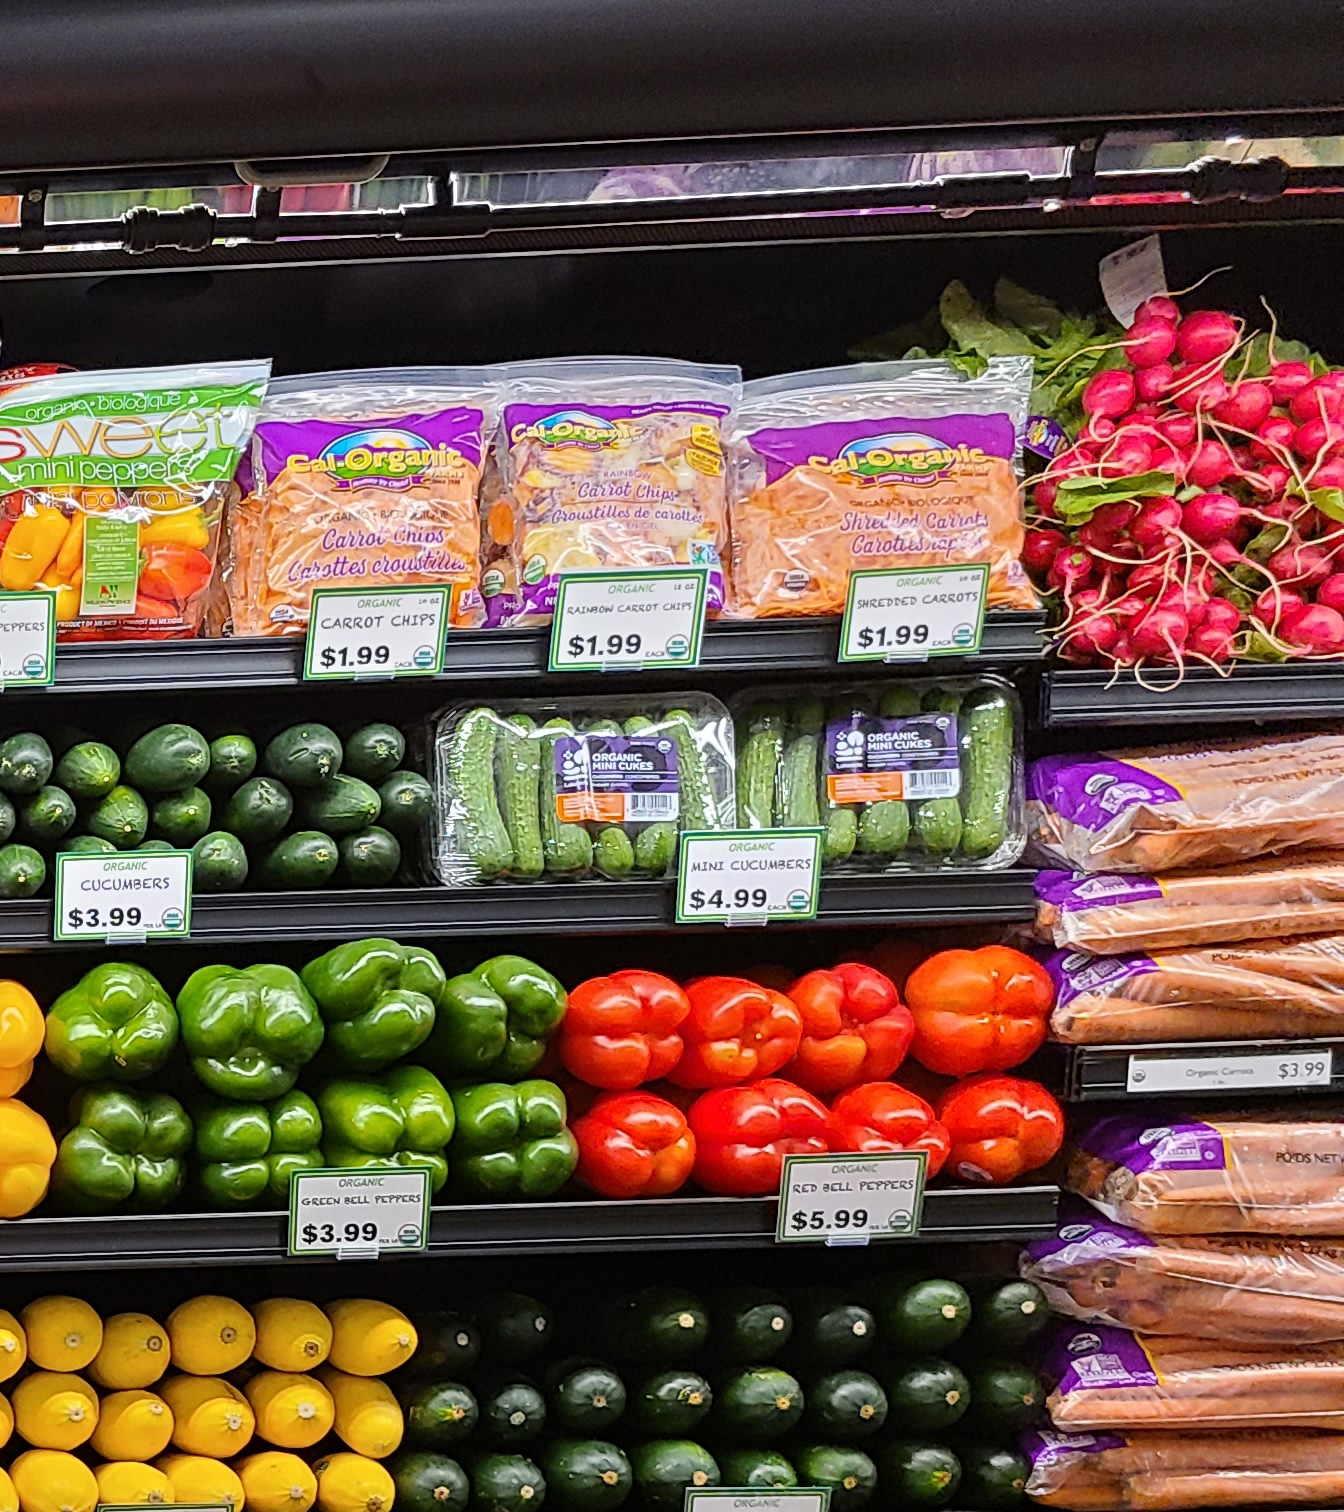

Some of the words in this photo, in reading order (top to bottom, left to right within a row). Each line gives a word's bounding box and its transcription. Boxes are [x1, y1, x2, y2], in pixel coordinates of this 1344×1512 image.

[808, 444, 987, 472] Cal-Organic
[18, 462, 74, 482] mini
[80, 457, 194, 483] peppers
[603, 469, 652, 480] RAINBOW
[578, 481, 631, 500] Carrot
[636, 486, 675, 503] Chips
[840, 512, 919, 532] Shredded
[925, 512, 989, 529] Carrots
[323, 528, 386, 551] Carrot
[394, 523, 444, 544] Chips
[567, 603, 612, 614] RAINBOW
[616, 602, 659, 613] CARROT
[662, 601, 693, 611] CHIPS
[857, 595, 918, 609] SHREDDED
[922, 592, 978, 605] CARROTS
[321, 615, 383, 629] CARROT
[391, 613, 435, 627] CHIPS
[567, 634, 641, 656] $1.99
[857, 624, 929, 648] $1.99
[320, 646, 390, 667] $1.99
[592, 753, 642, 763] ORGANIC
[592, 762, 616, 770] MINI
[618, 762, 653, 771] CUKES
[691, 861, 725, 873] MINI
[730, 857, 811, 871] CUCUMBERS
[81, 878, 169, 891] CUCUMBERS
[690, 888, 767, 911] $4.99
[68, 907, 141, 929] $3.99
[1278, 1061, 1325, 1080] $3.99
[793, 1184, 817, 1193] RED
[823, 1182, 853, 1192] BELL
[859, 1180, 914, 1191] PEPPERS
[301, 1197, 340, 1206] GREEN
[344, 1196, 370, 1205] BELL
[375, 1195, 421, 1204] PEPPERS
[791, 1209, 868, 1231] $5.99
[302, 1223, 377, 1245] $3.99
